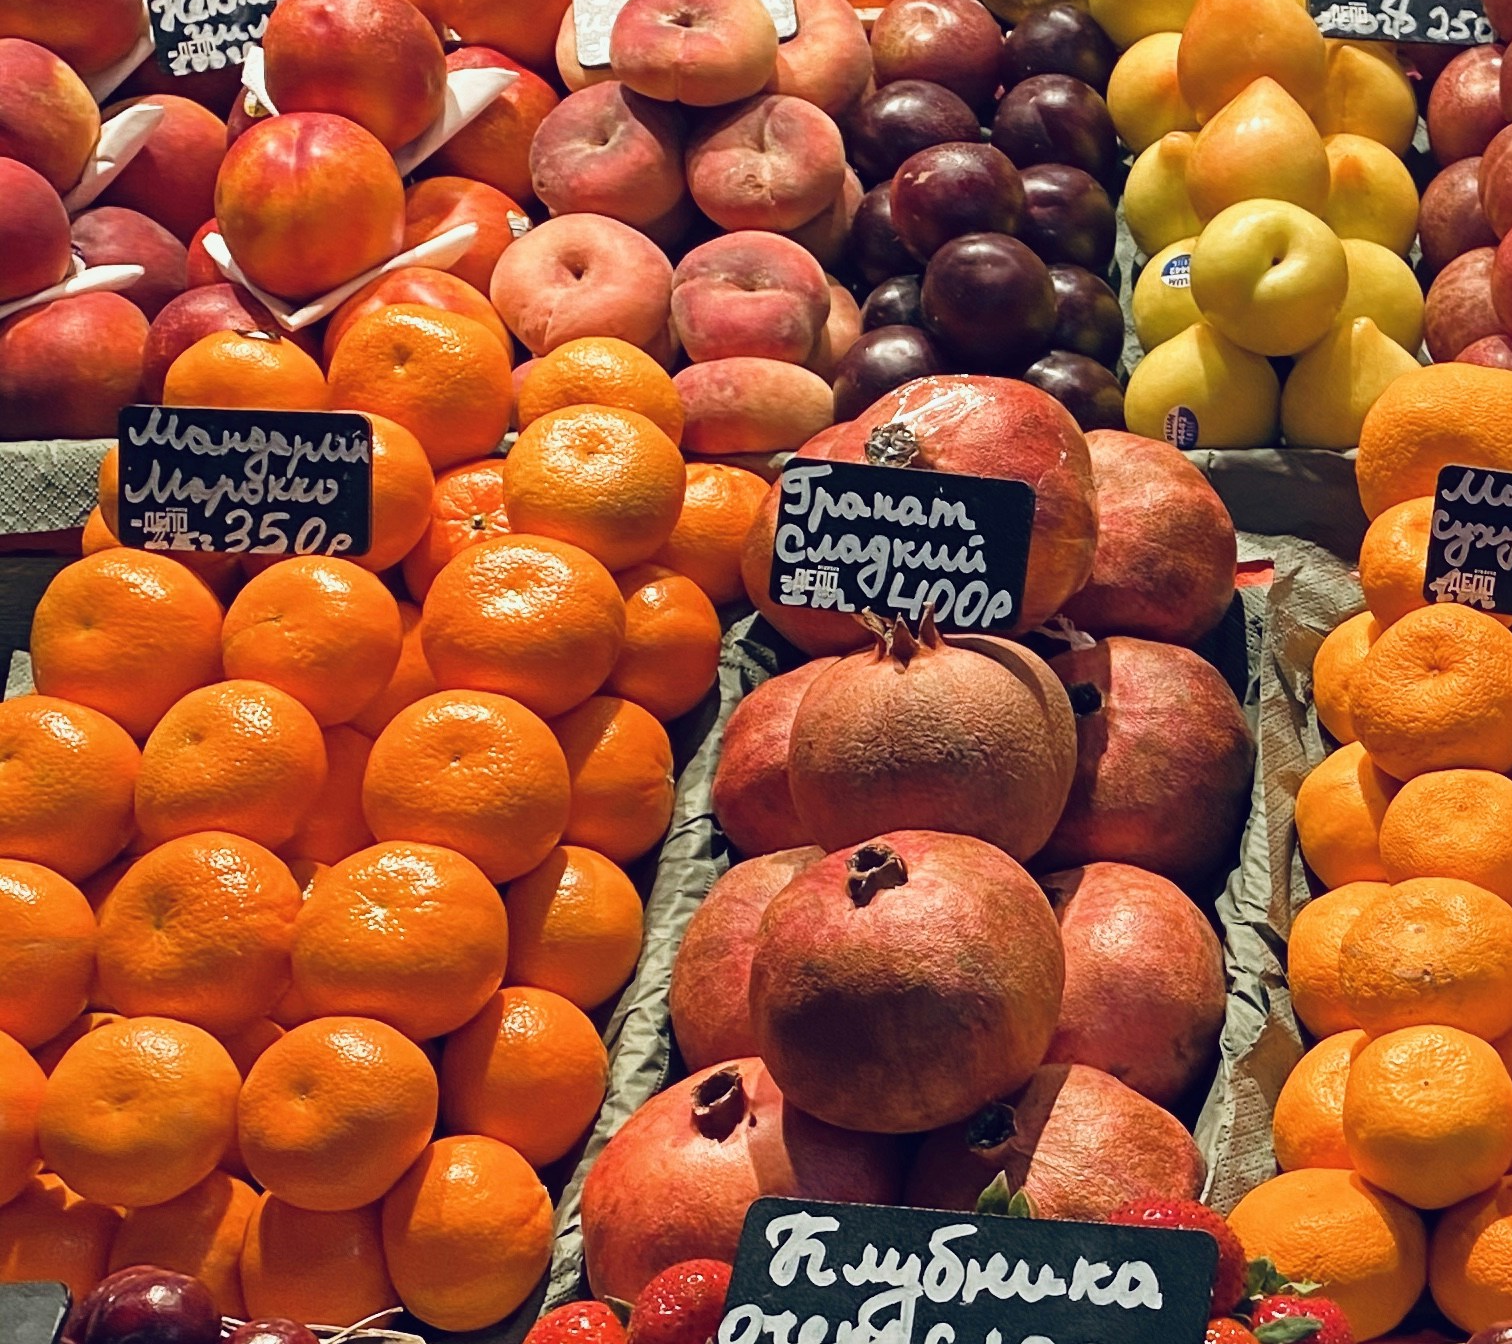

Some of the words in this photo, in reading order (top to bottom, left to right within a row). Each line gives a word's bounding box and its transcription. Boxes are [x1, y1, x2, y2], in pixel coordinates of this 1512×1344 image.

[1166, 413, 1177, 440] PLUM
[125, 459, 339, 517] Марокко
[783, 464, 975, 533] Гранат
[776, 523, 987, 598] Сладкий
[766, 1210, 1163, 1310] Клубника
